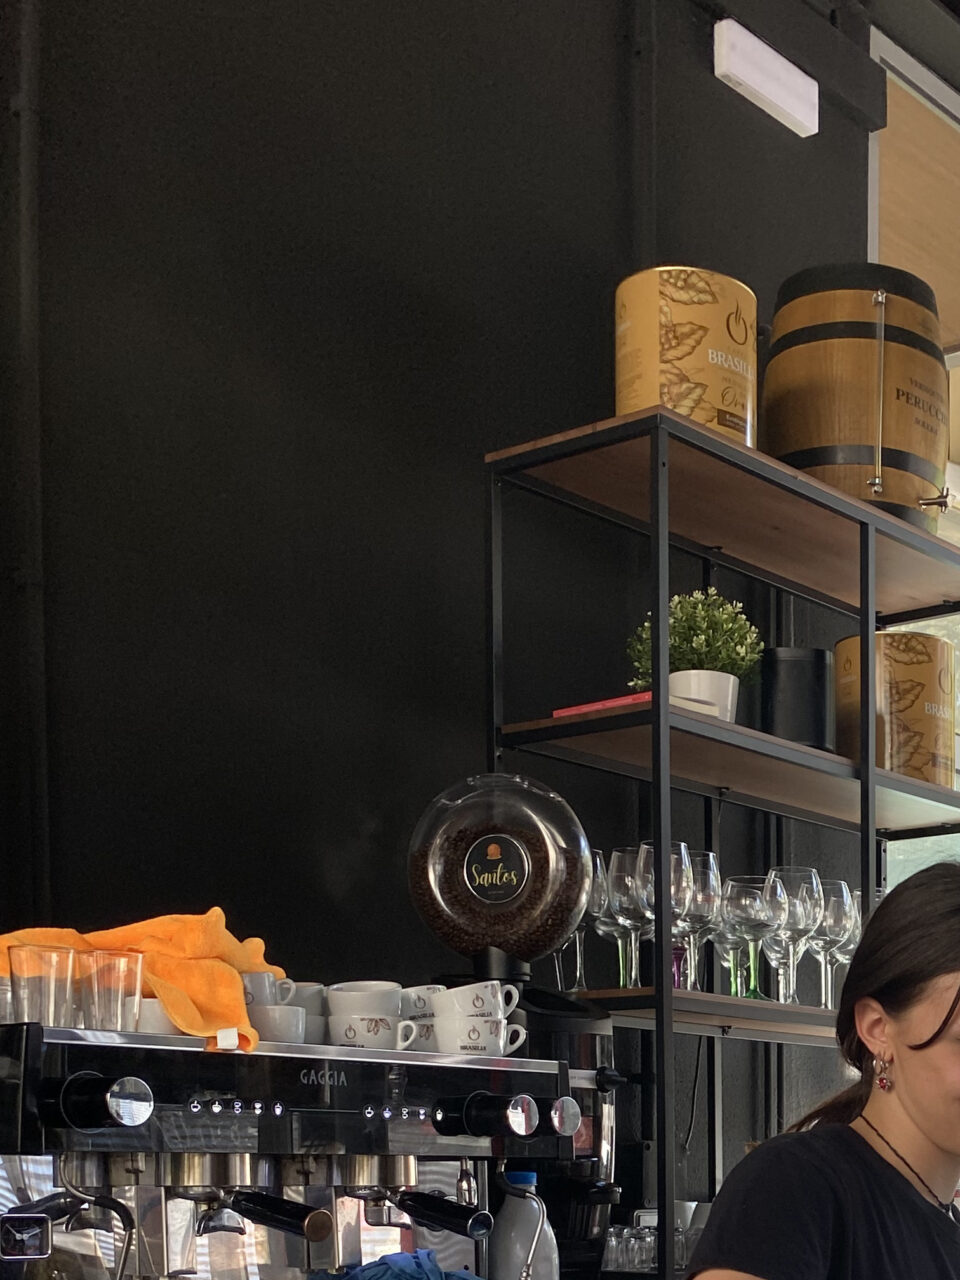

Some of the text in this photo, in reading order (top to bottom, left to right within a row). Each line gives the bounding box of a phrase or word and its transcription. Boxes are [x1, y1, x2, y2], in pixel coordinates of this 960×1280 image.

[708, 348, 755, 378] BRASILI
[896, 387, 948, 427] PERUCC
[471, 862, 518, 887] Santos
[300, 1069, 348, 1087] GAGGIA
